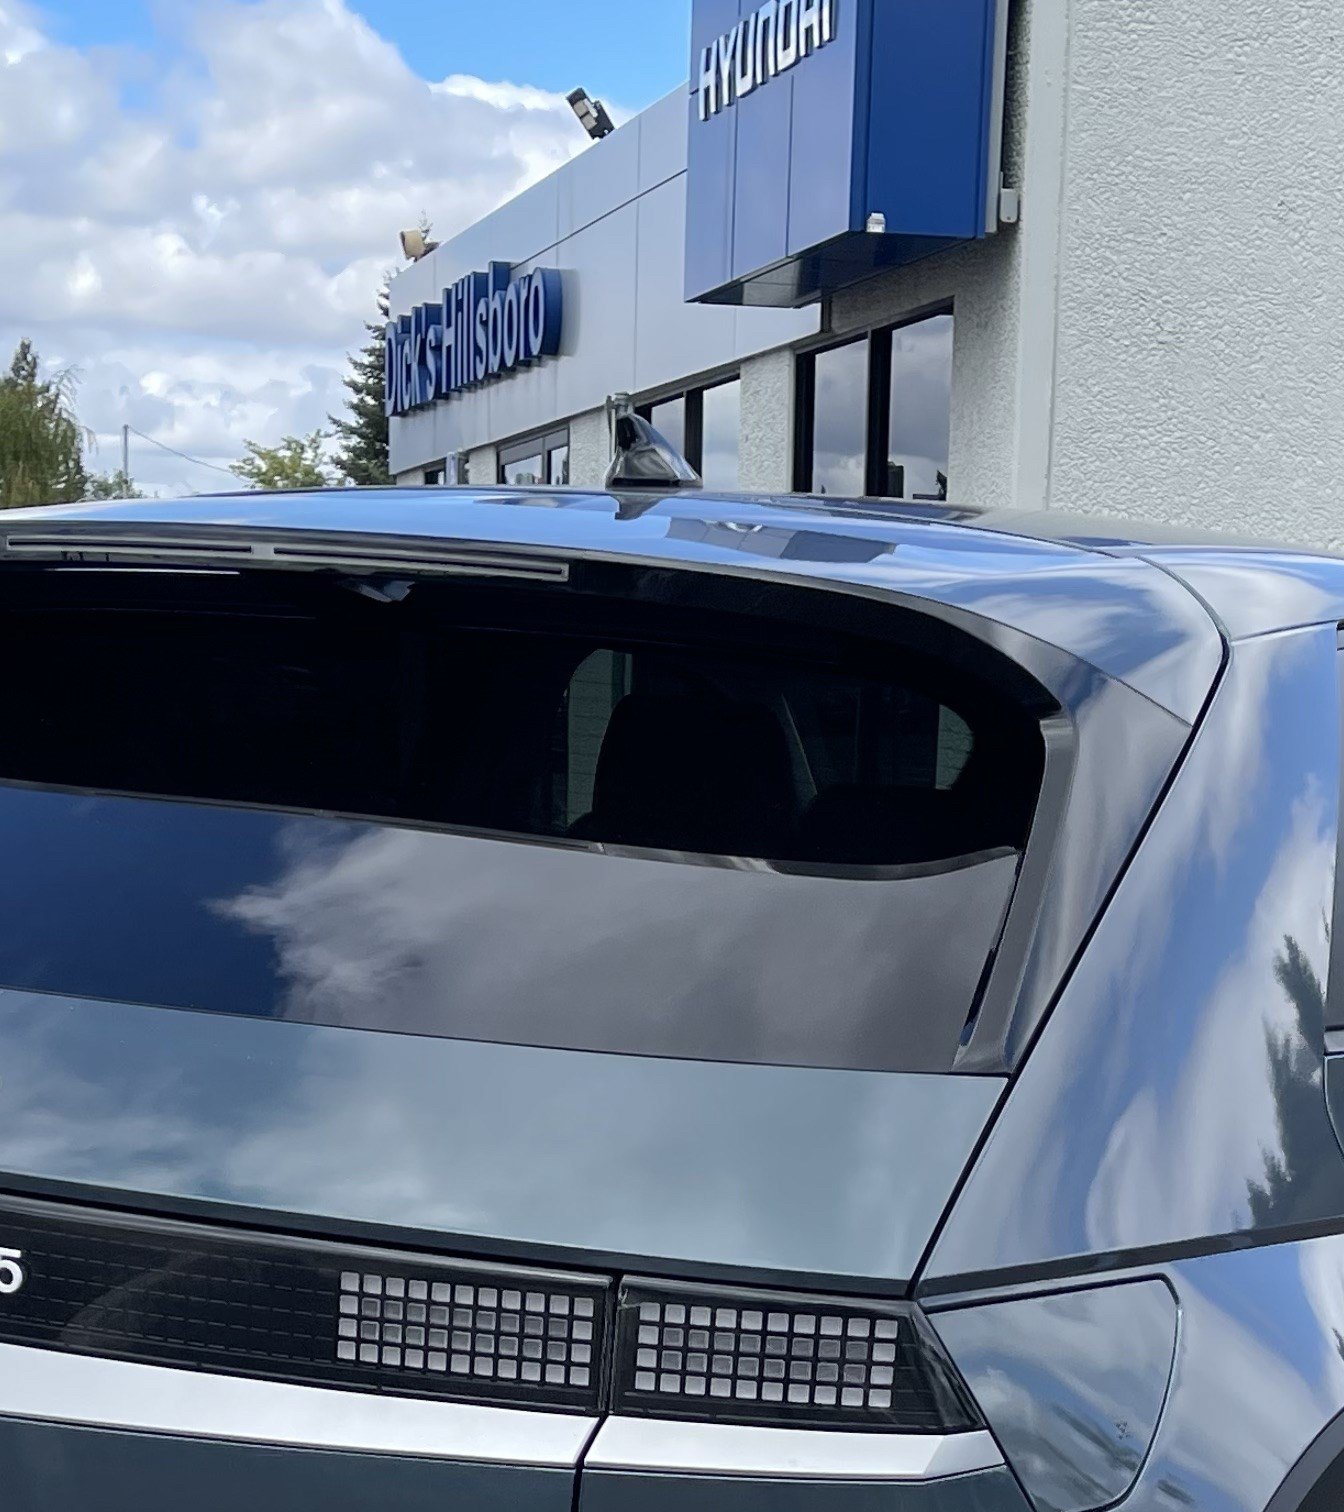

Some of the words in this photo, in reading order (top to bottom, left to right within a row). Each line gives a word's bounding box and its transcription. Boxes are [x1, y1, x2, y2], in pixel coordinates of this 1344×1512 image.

[698, 0, 834, 121] HYUNDAI
[385, 303, 438, 417] Dick's
[442, 260, 549, 393] Hillsboro
